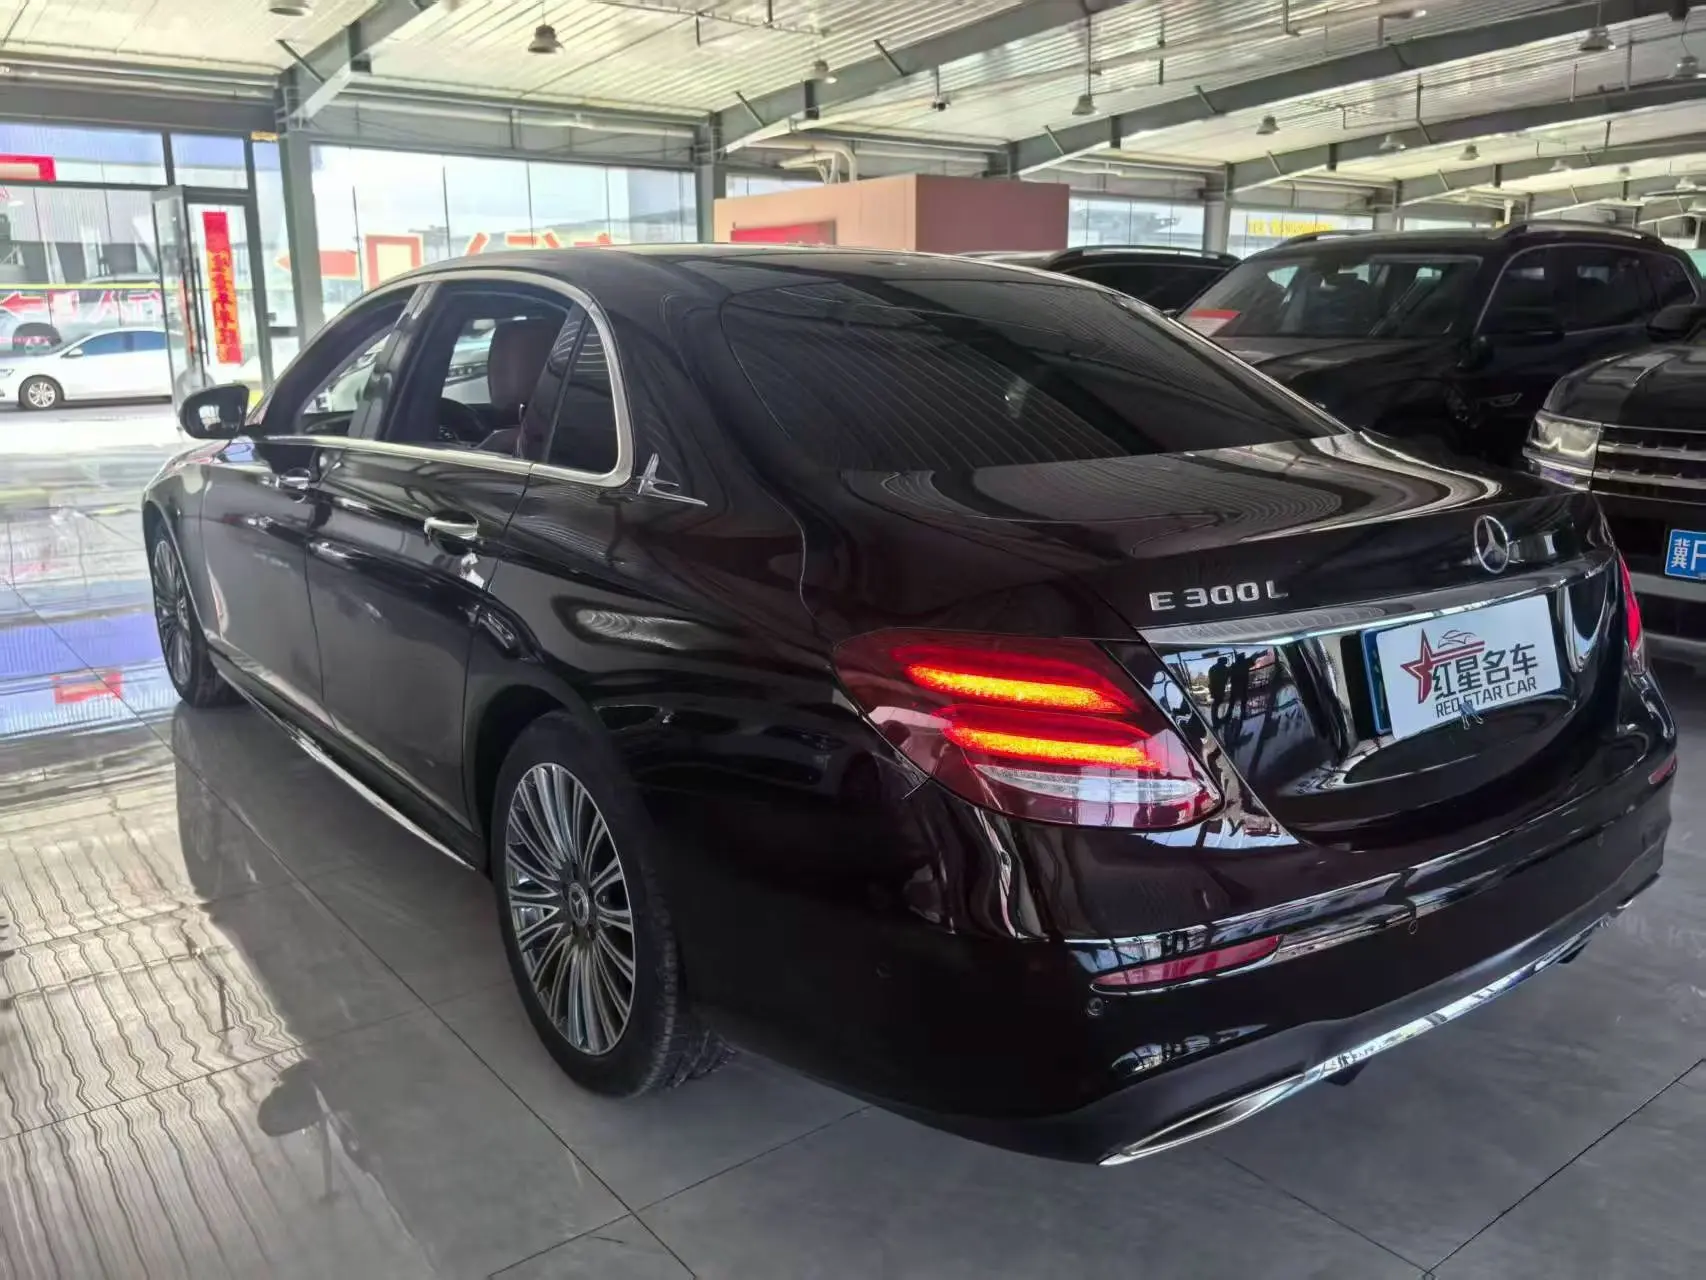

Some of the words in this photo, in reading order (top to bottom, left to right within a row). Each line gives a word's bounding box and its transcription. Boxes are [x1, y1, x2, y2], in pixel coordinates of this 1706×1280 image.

[1432, 643, 1538, 700] 红星名车
[1435, 698, 1461, 718] RED
[1506, 676, 1538, 697] CAR
